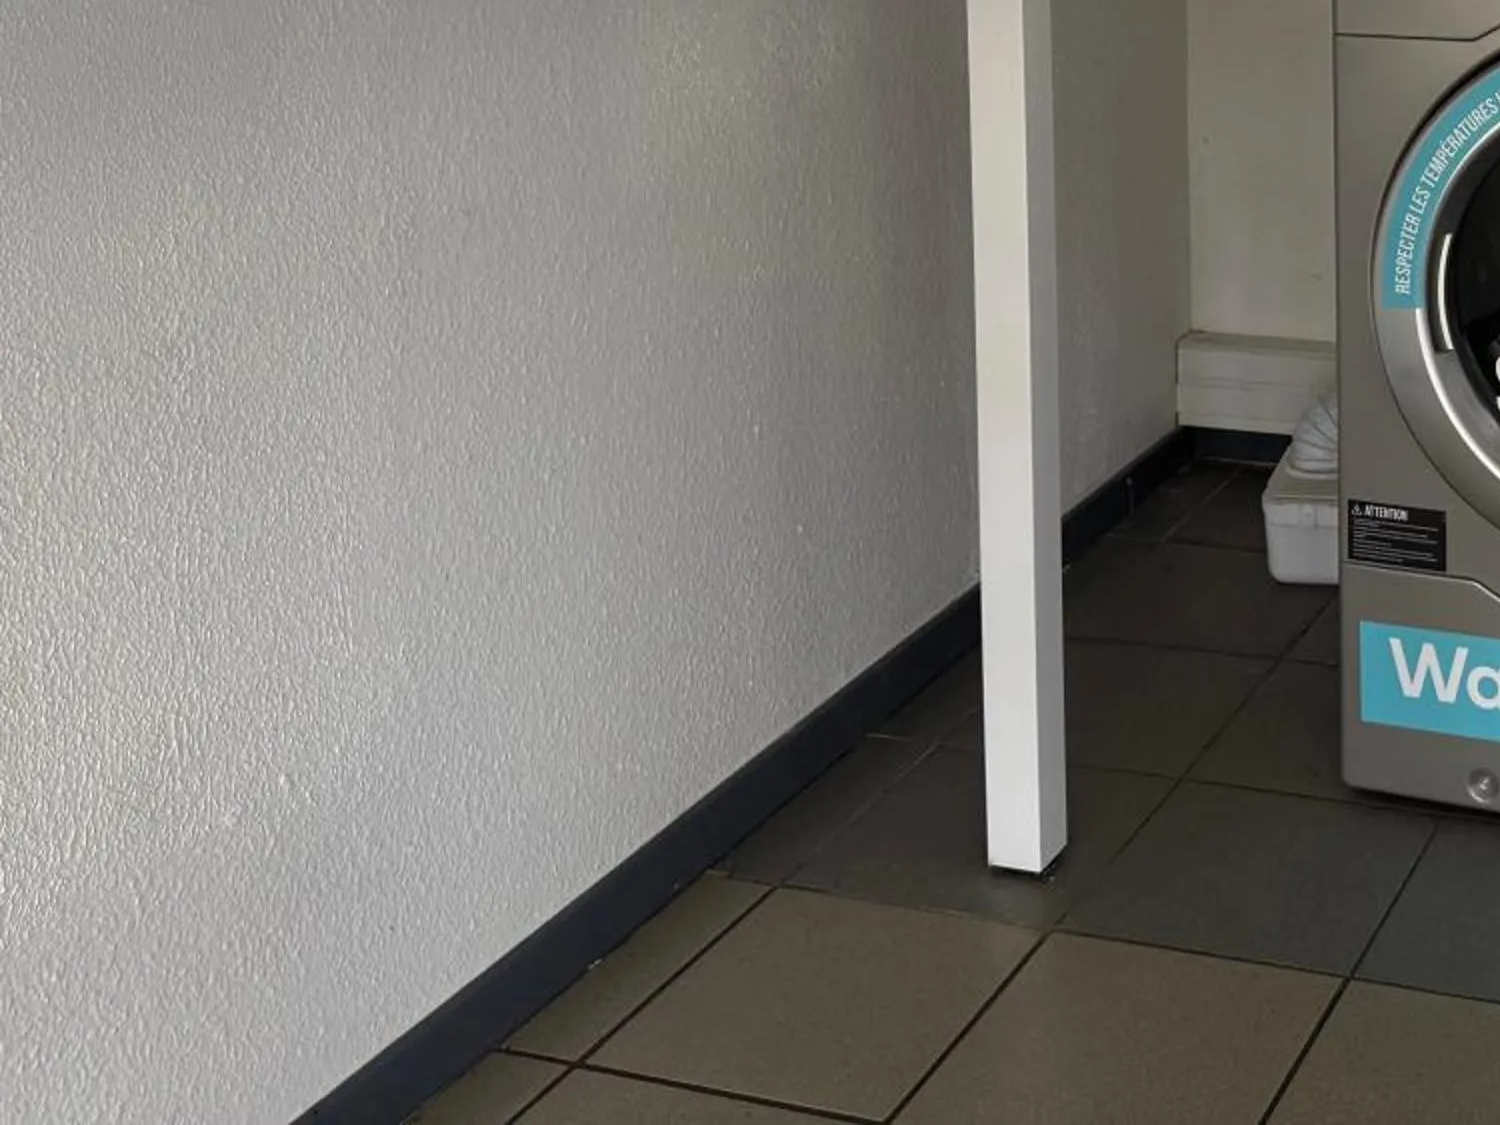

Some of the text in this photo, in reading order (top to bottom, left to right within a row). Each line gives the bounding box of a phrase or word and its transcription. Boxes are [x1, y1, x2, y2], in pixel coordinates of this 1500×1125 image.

[1395, 211, 1421, 295] RESPECTER
[1411, 187, 1432, 214] LES
[1422, 97, 1500, 190] TEMPÉRATURES
